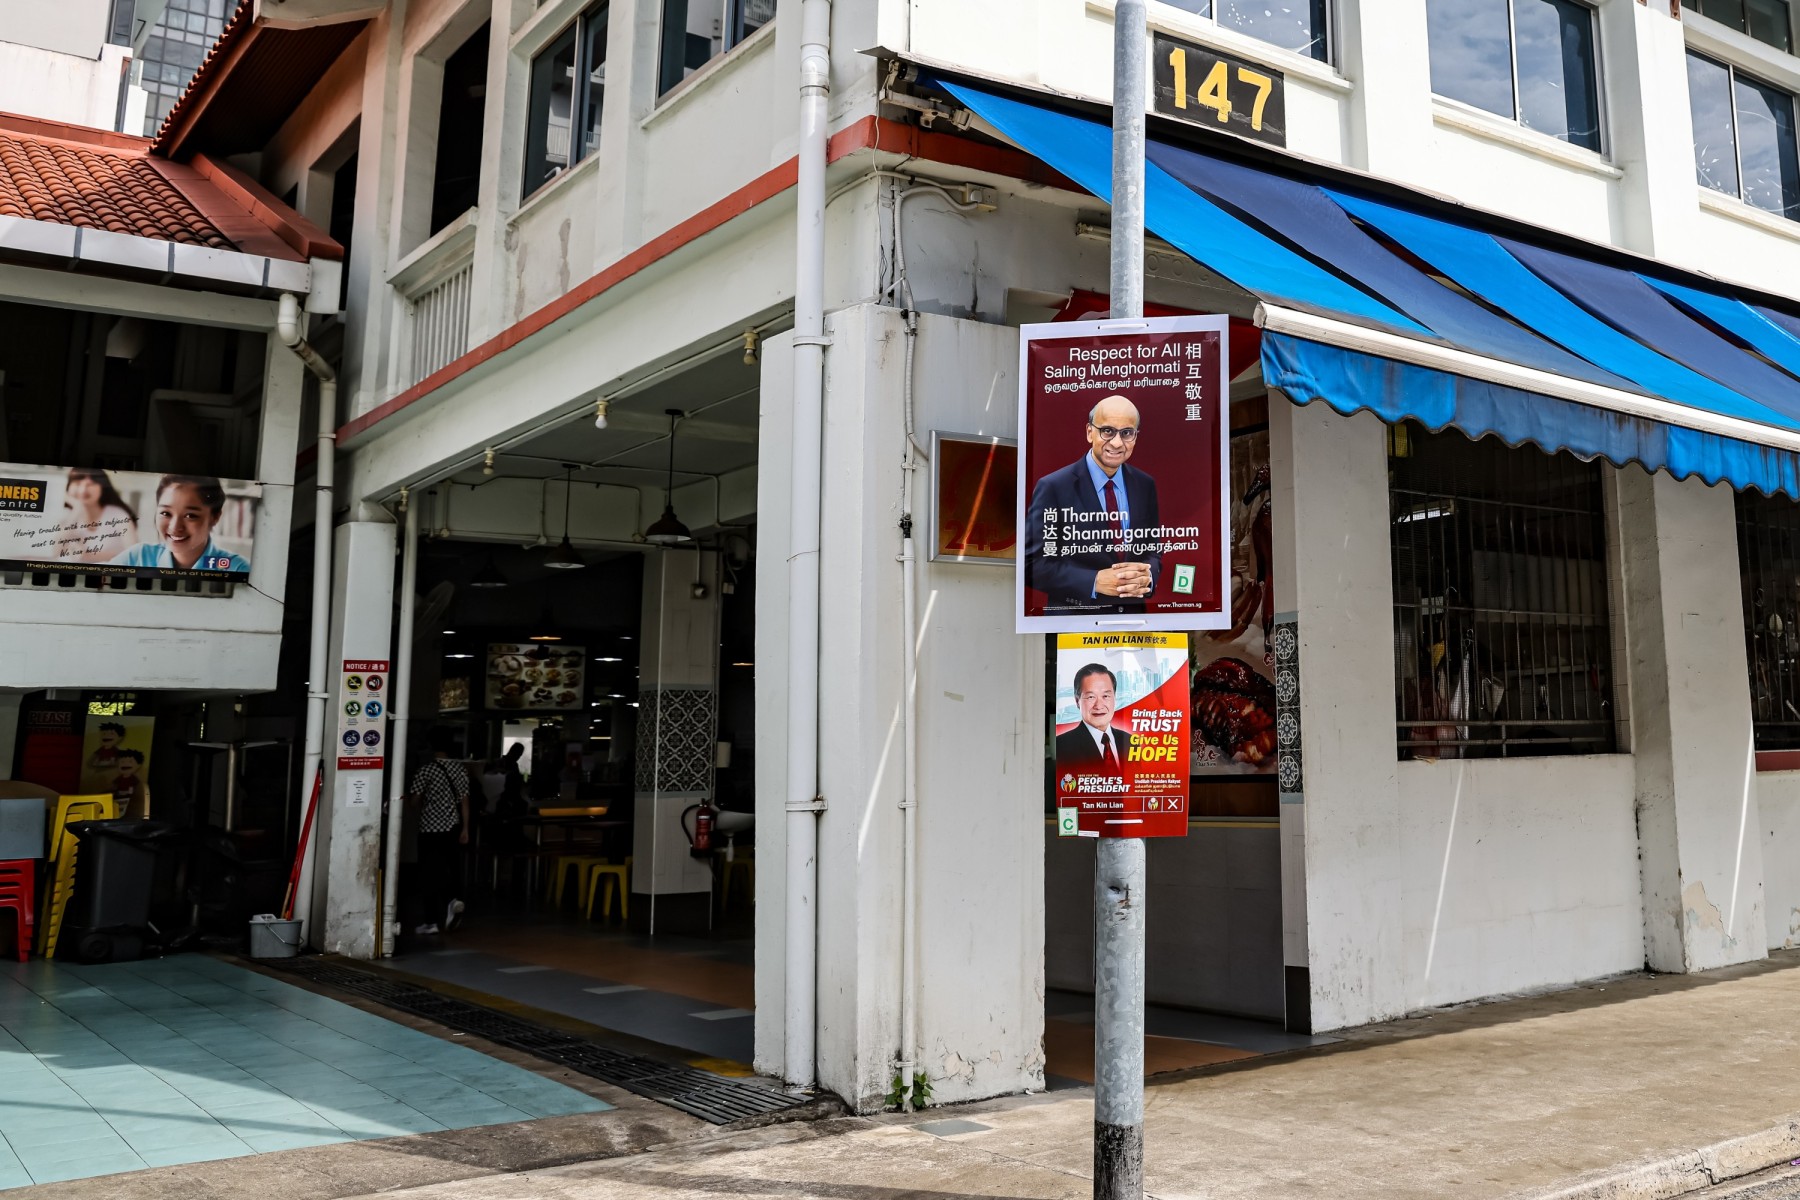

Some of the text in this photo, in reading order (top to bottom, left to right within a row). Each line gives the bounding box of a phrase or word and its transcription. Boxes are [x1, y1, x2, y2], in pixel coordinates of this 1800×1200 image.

[1169, 47, 1272, 132] 147
[1069, 343, 1180, 364] Respect for All
[1044, 360, 1180, 380] Saling Menghormati
[1044, 377, 1180, 394] ஒருவருக்கொருவர் மரியாதை
[1184, 343, 1202, 421] 相互敬重
[1062, 507, 1128, 523] Tharman
[14, 529, 36, 538] Having
[38, 524, 61, 534] trouble
[64, 523, 78, 531] with
[84, 535, 98, 543] your
[100, 528, 128, 541] grades?
[1042, 507, 1058, 557] 尚达曼
[1062, 525, 1199, 544] Shanmugaratnam
[60, 548, 70, 558] We
[86, 545, 103, 556] help!
[1061, 540, 1198, 556] தர்மன் சண்முகரத்னம்
[26, 562, 136, 573] thejuniorlearners.com.sg
[1178, 576, 1188, 587] D
[1082, 637, 1100, 645] TAN
[1103, 636, 1120, 644] KIN
[1122, 635, 1144, 644] LIAN
[1132, 709, 1182, 718] Bring Back
[1132, 719, 1181, 732] TRUST
[1130, 734, 1179, 745] Give Us
[1128, 747, 1178, 761] HOPE
[1078, 777, 1122, 785] PEOPLE'S
[1078, 785, 1130, 793] PRESIDENT
[1063, 818, 1073, 830] C
